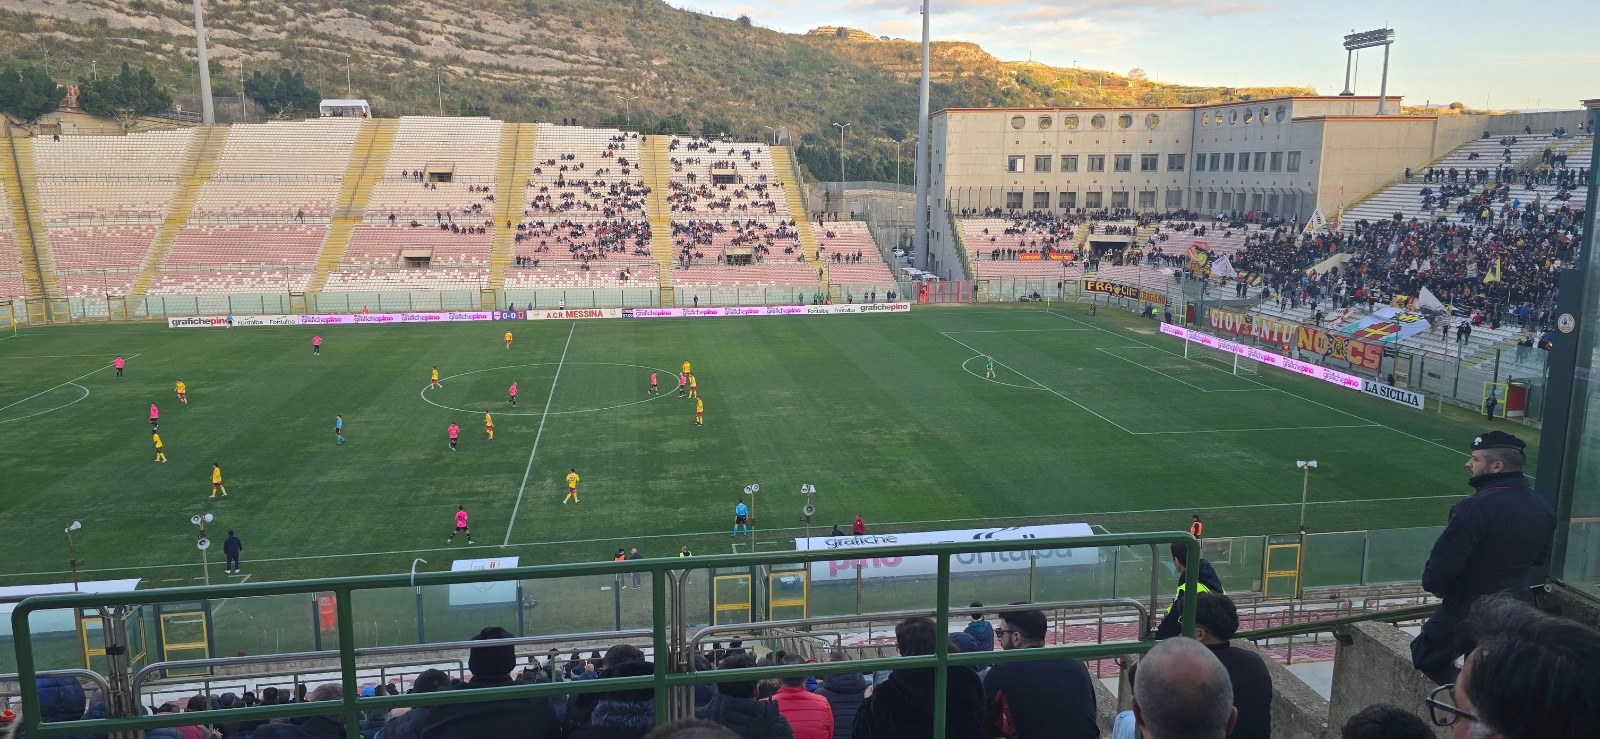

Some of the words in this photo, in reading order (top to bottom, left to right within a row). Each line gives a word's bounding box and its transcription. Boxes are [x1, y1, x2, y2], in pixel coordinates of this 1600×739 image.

[860, 303, 908, 312] grafichepino
[565, 310, 604, 318] MESSINA
[1365, 381, 1378, 395] LA
[1379, 386, 1420, 407] SICILIA
[825, 534, 898, 549] grafiche
